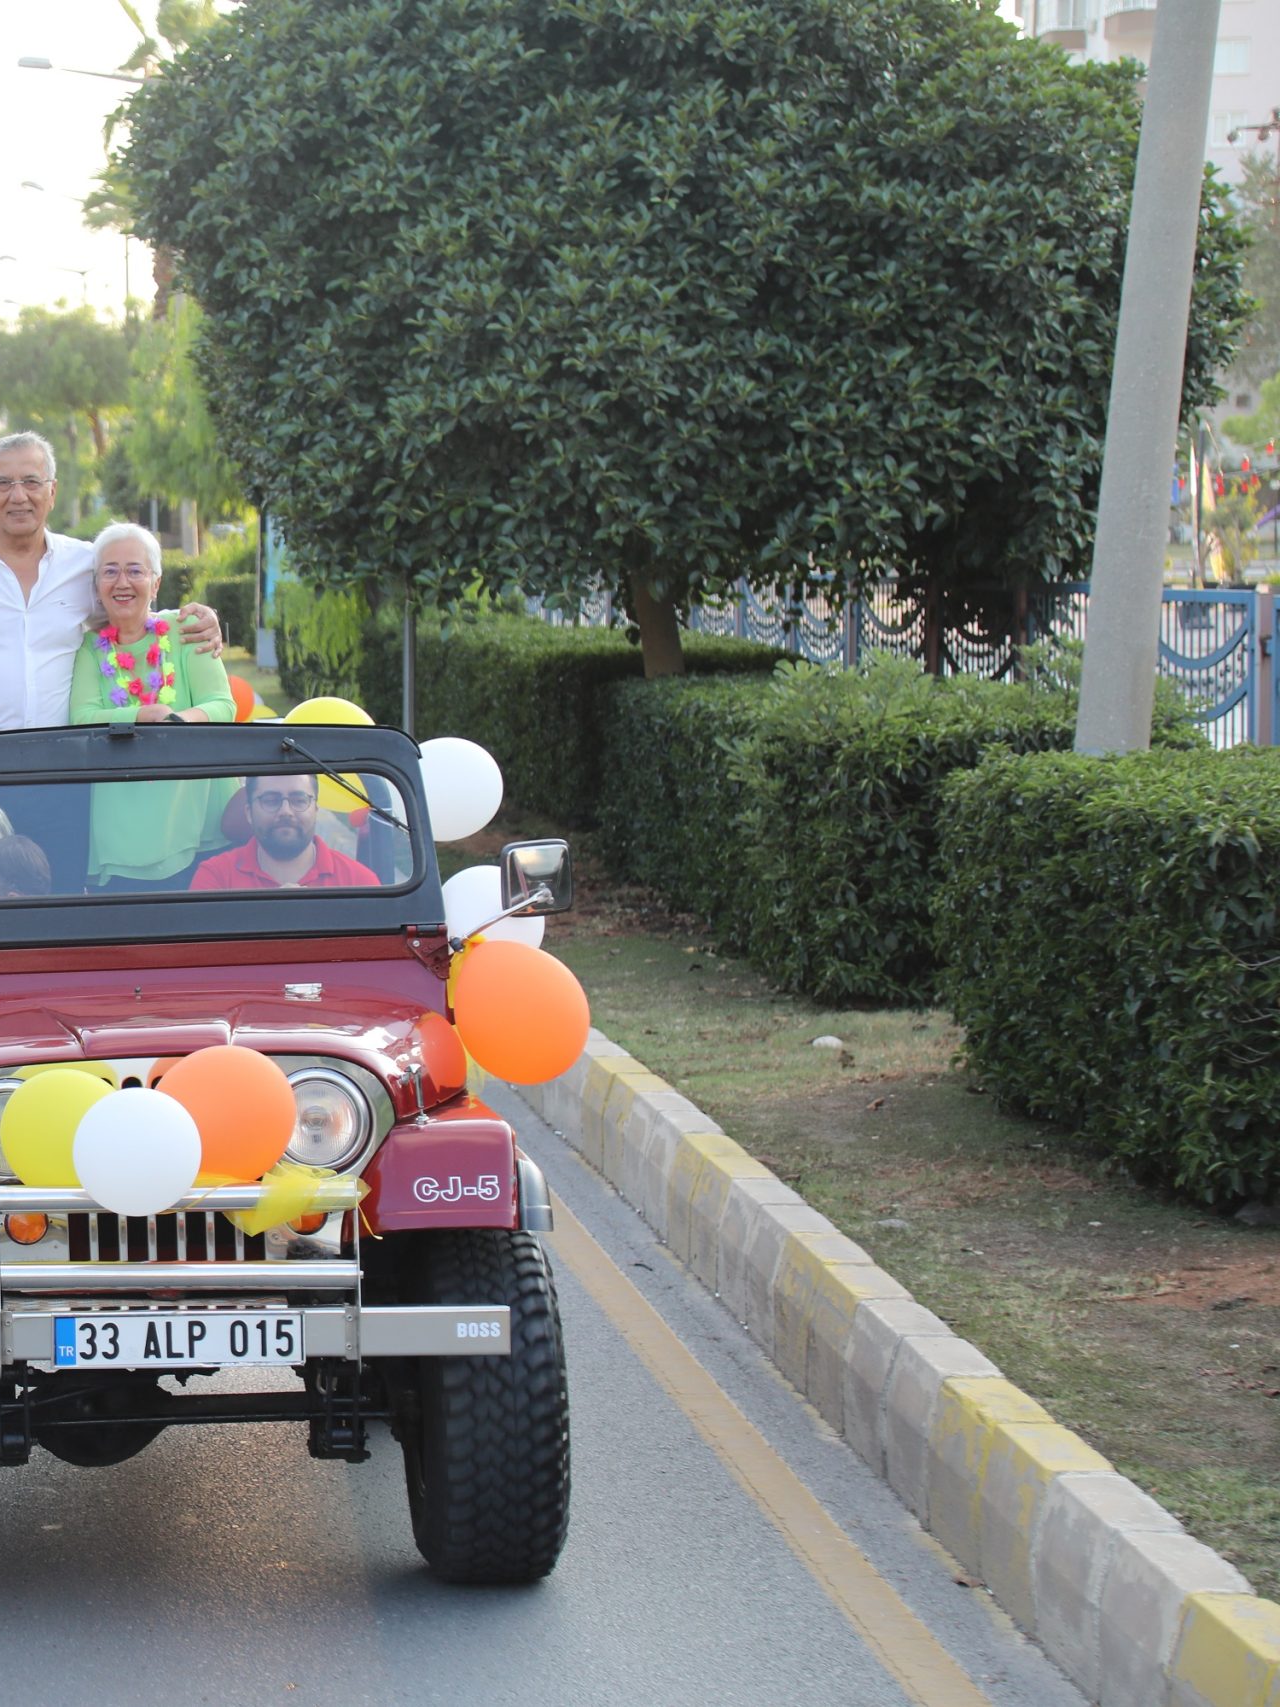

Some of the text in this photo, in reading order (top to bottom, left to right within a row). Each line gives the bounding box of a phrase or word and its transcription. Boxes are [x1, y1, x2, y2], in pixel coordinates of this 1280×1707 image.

[413, 1175, 500, 1202] CJ-5
[79, 1319, 294, 1360] 33 ALP 015
[456, 1322, 501, 1338] BOSS
[59, 1346, 74, 1356] TR
